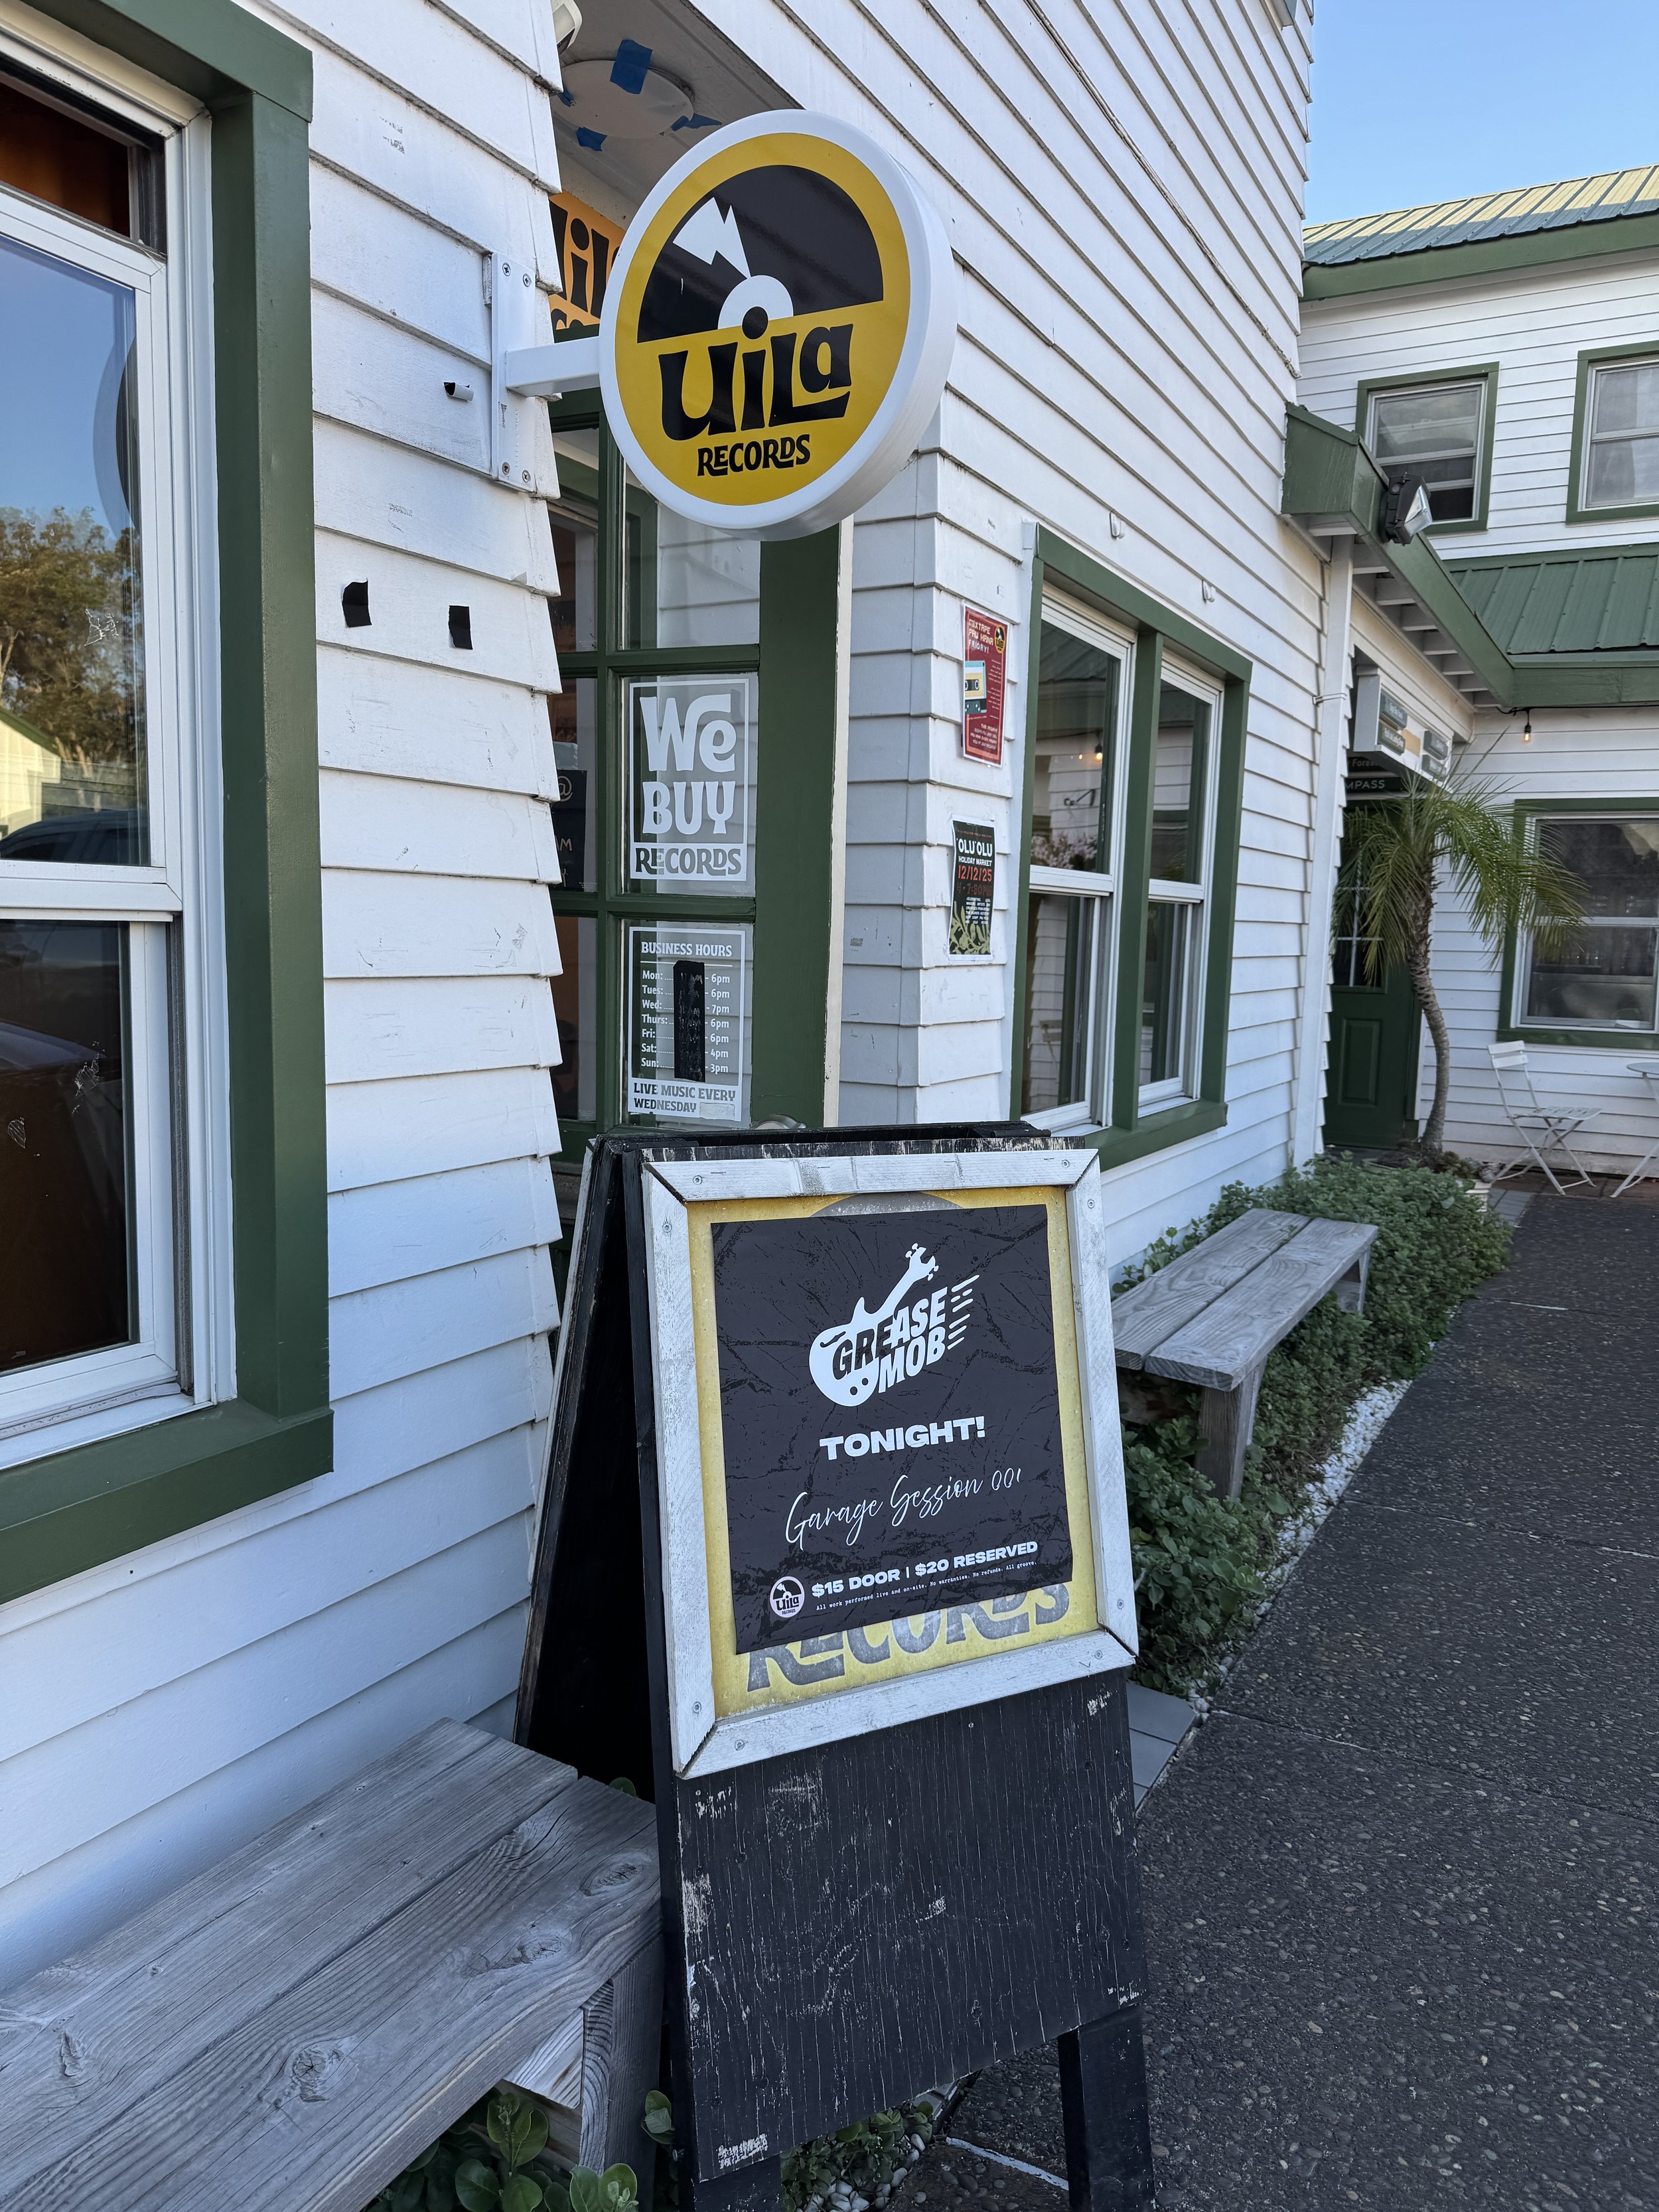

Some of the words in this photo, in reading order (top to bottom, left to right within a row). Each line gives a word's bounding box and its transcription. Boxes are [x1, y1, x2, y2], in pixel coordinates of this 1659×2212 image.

[697, 433, 810, 477] RECORDS
[640, 694, 737, 772] We
[642, 781, 735, 834] BUY
[635, 848, 741, 876] RECORDS
[958, 855, 975, 865] HOLIDAY
[975, 858, 992, 867] MARKET
[958, 865, 992, 882] 12/12/25
[641, 942, 693, 956] BUSINESS
[695, 944, 733, 957] HOURS
[642, 970, 663, 980] Mon:
[711, 974, 731, 986] 6pm
[642, 985, 663, 995] Tues:
[711, 989, 730, 1000] 6pm
[642, 999, 662, 1009] Wed:
[711, 1005, 729, 1015] 7pm
[642, 1014, 668, 1024] Thurs:
[710, 1019, 729, 1030] 6pm
[642, 1029, 656, 1038] Fri:
[710, 1034, 729, 1045] 6pm
[641, 1043, 657, 1053] Sat:
[710, 1049, 729, 1059] 4pm
[641, 1058, 659, 1068] Sun:
[710, 1064, 729, 1074] 3pm
[634, 1082, 658, 1095] LIVE
[661, 1084, 695, 1098] MUSIC
[698, 1088, 736, 1102] EVERY
[634, 1098, 697, 1113] WEDNESDAY
[832, 1287, 948, 1380] GREASE
[878, 1327, 946, 1393] MOB
[819, 1416, 985, 1461] TONIGHT!
[784, 1491, 883, 1551] Garage
[889, 1473, 983, 1520] Session
[812, 1580, 844, 1598] $15
[849, 1569, 901, 1590] DOOR
[915, 1559, 949, 1578] $20
[954, 1541, 1038, 1568] RESERVED
[845, 1594, 873, 1605] performed
[938, 1574, 970, 1585] warranties.
[981, 1567, 1003, 1576] refunds.
[1017, 1561, 1037, 1570] groove.
